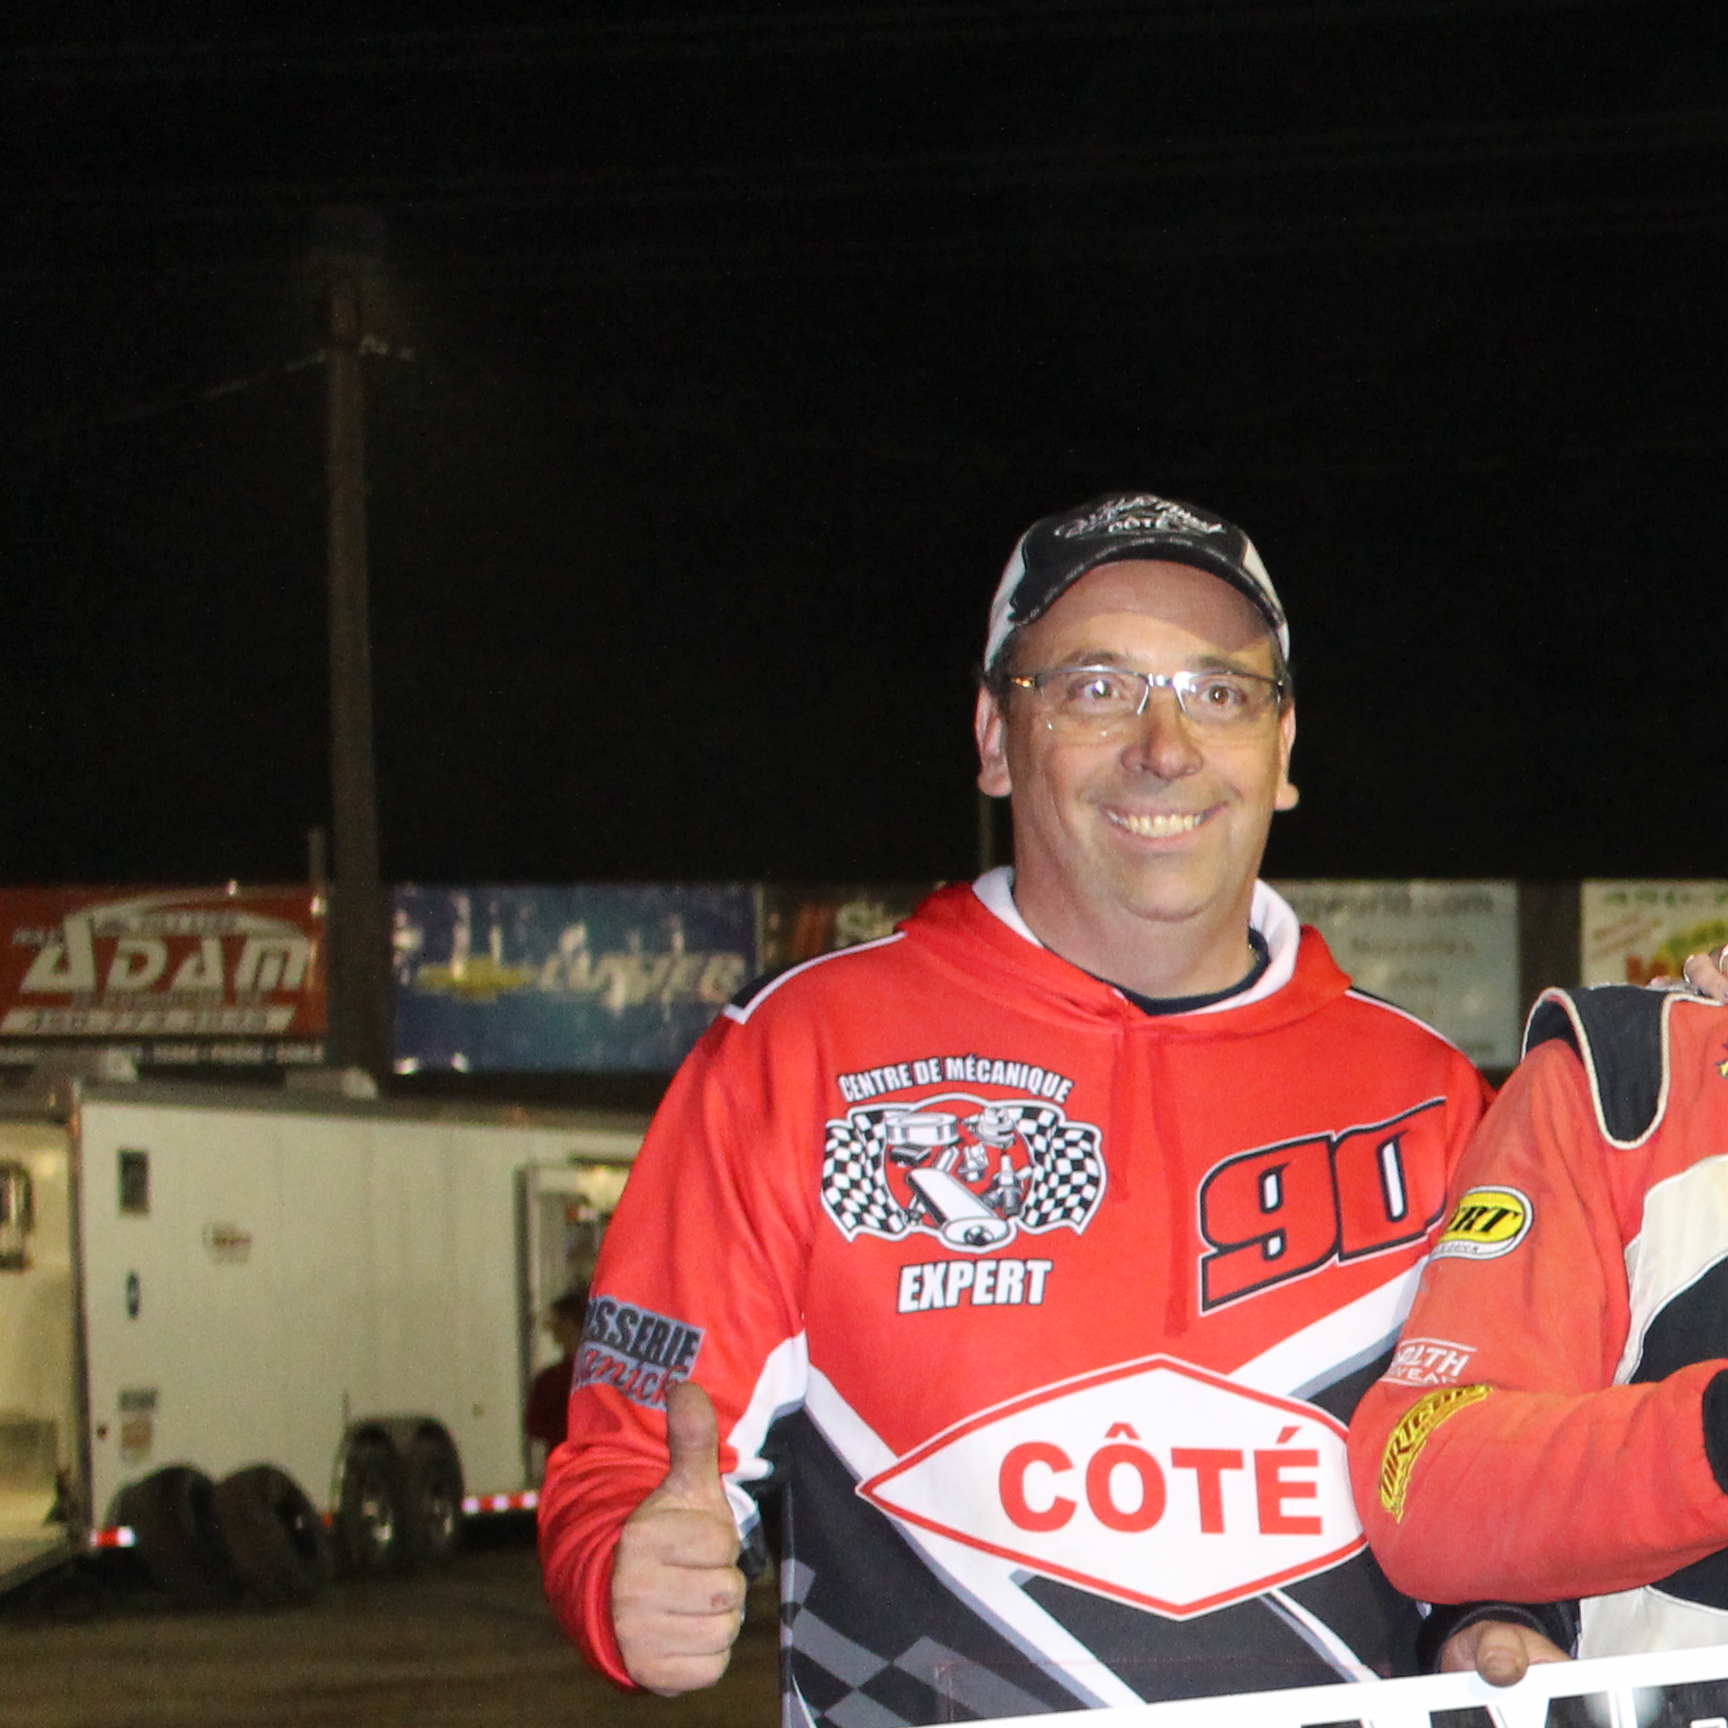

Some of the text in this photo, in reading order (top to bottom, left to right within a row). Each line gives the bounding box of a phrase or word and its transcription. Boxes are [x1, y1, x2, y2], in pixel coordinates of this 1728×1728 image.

[18, 912, 310, 992] ADAM
[838, 1053, 1075, 1104] CENTRE DE MÉCANIQUE
[1199, 1097, 1448, 1316] 90
[897, 1258, 1054, 1314] EXPERT
[999, 1423, 1323, 1536] CÔTÉ
